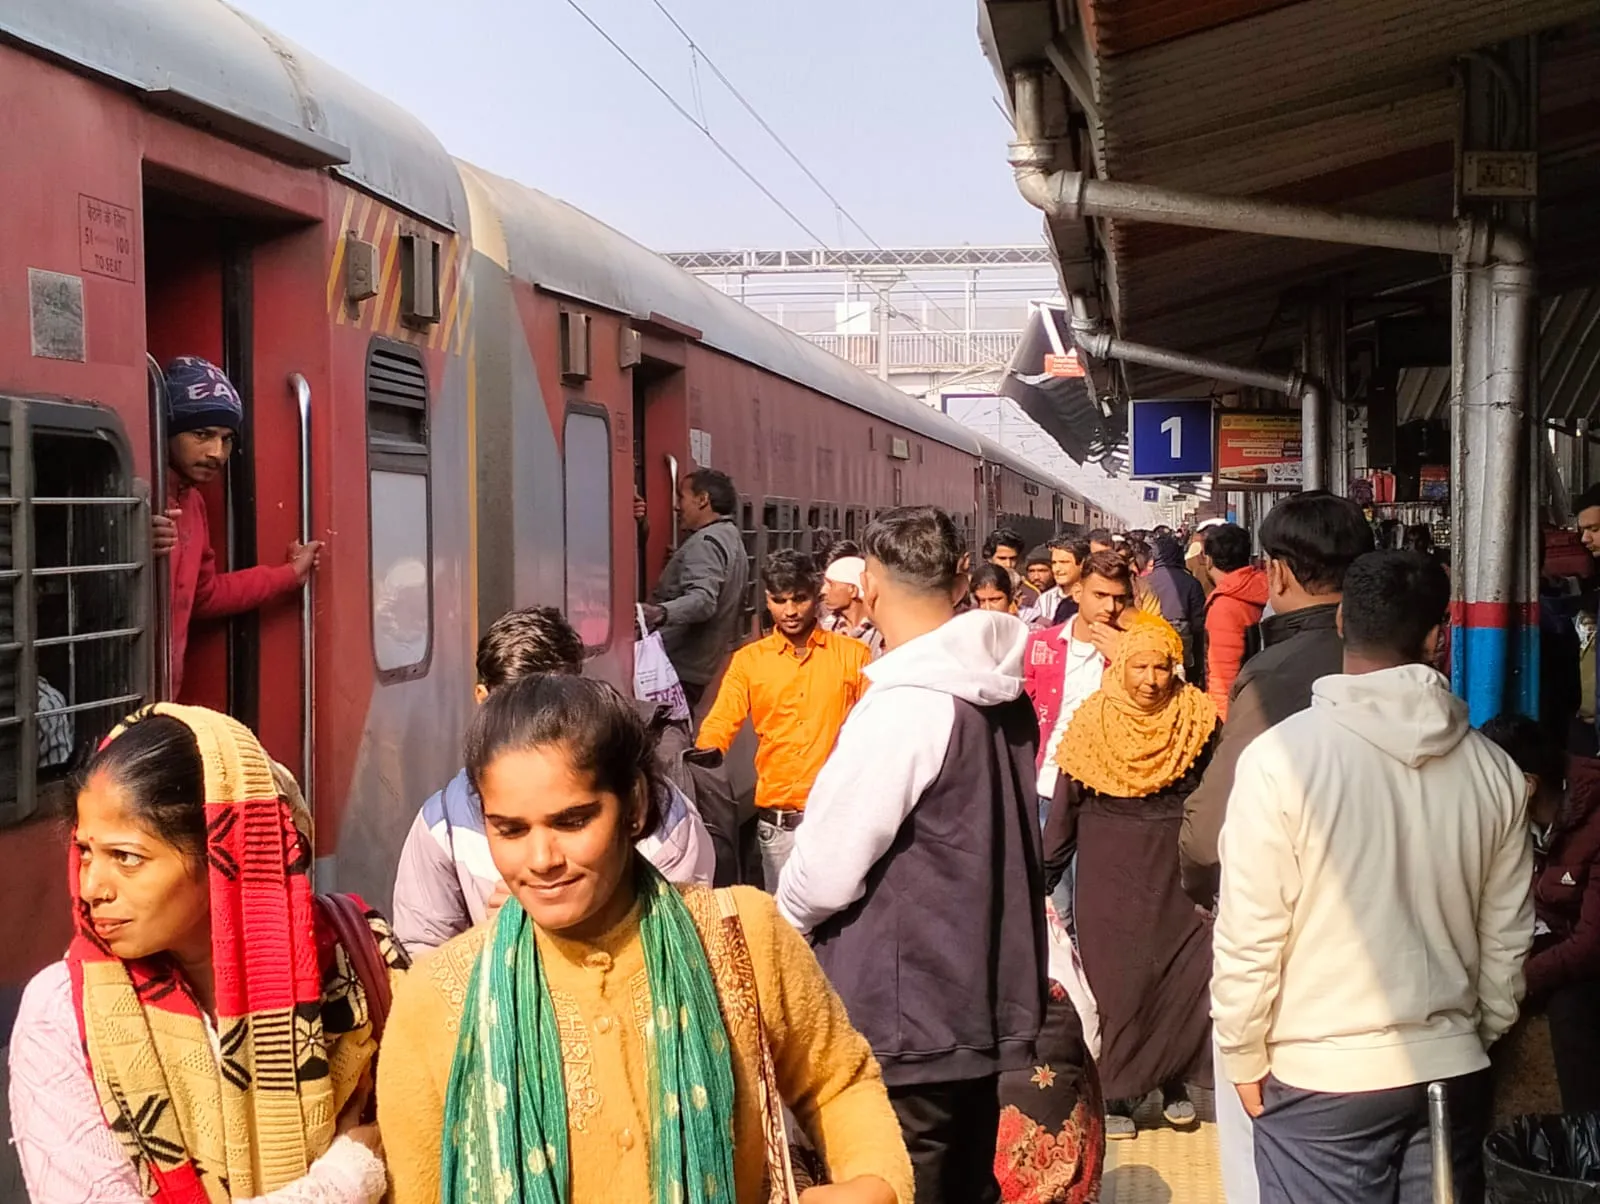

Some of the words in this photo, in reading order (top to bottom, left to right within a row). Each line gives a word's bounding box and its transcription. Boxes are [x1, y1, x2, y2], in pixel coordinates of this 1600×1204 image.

[94, 254, 104, 270] TO
[105, 257, 122, 274] SEAT
[1160, 416, 1183, 459] 1
